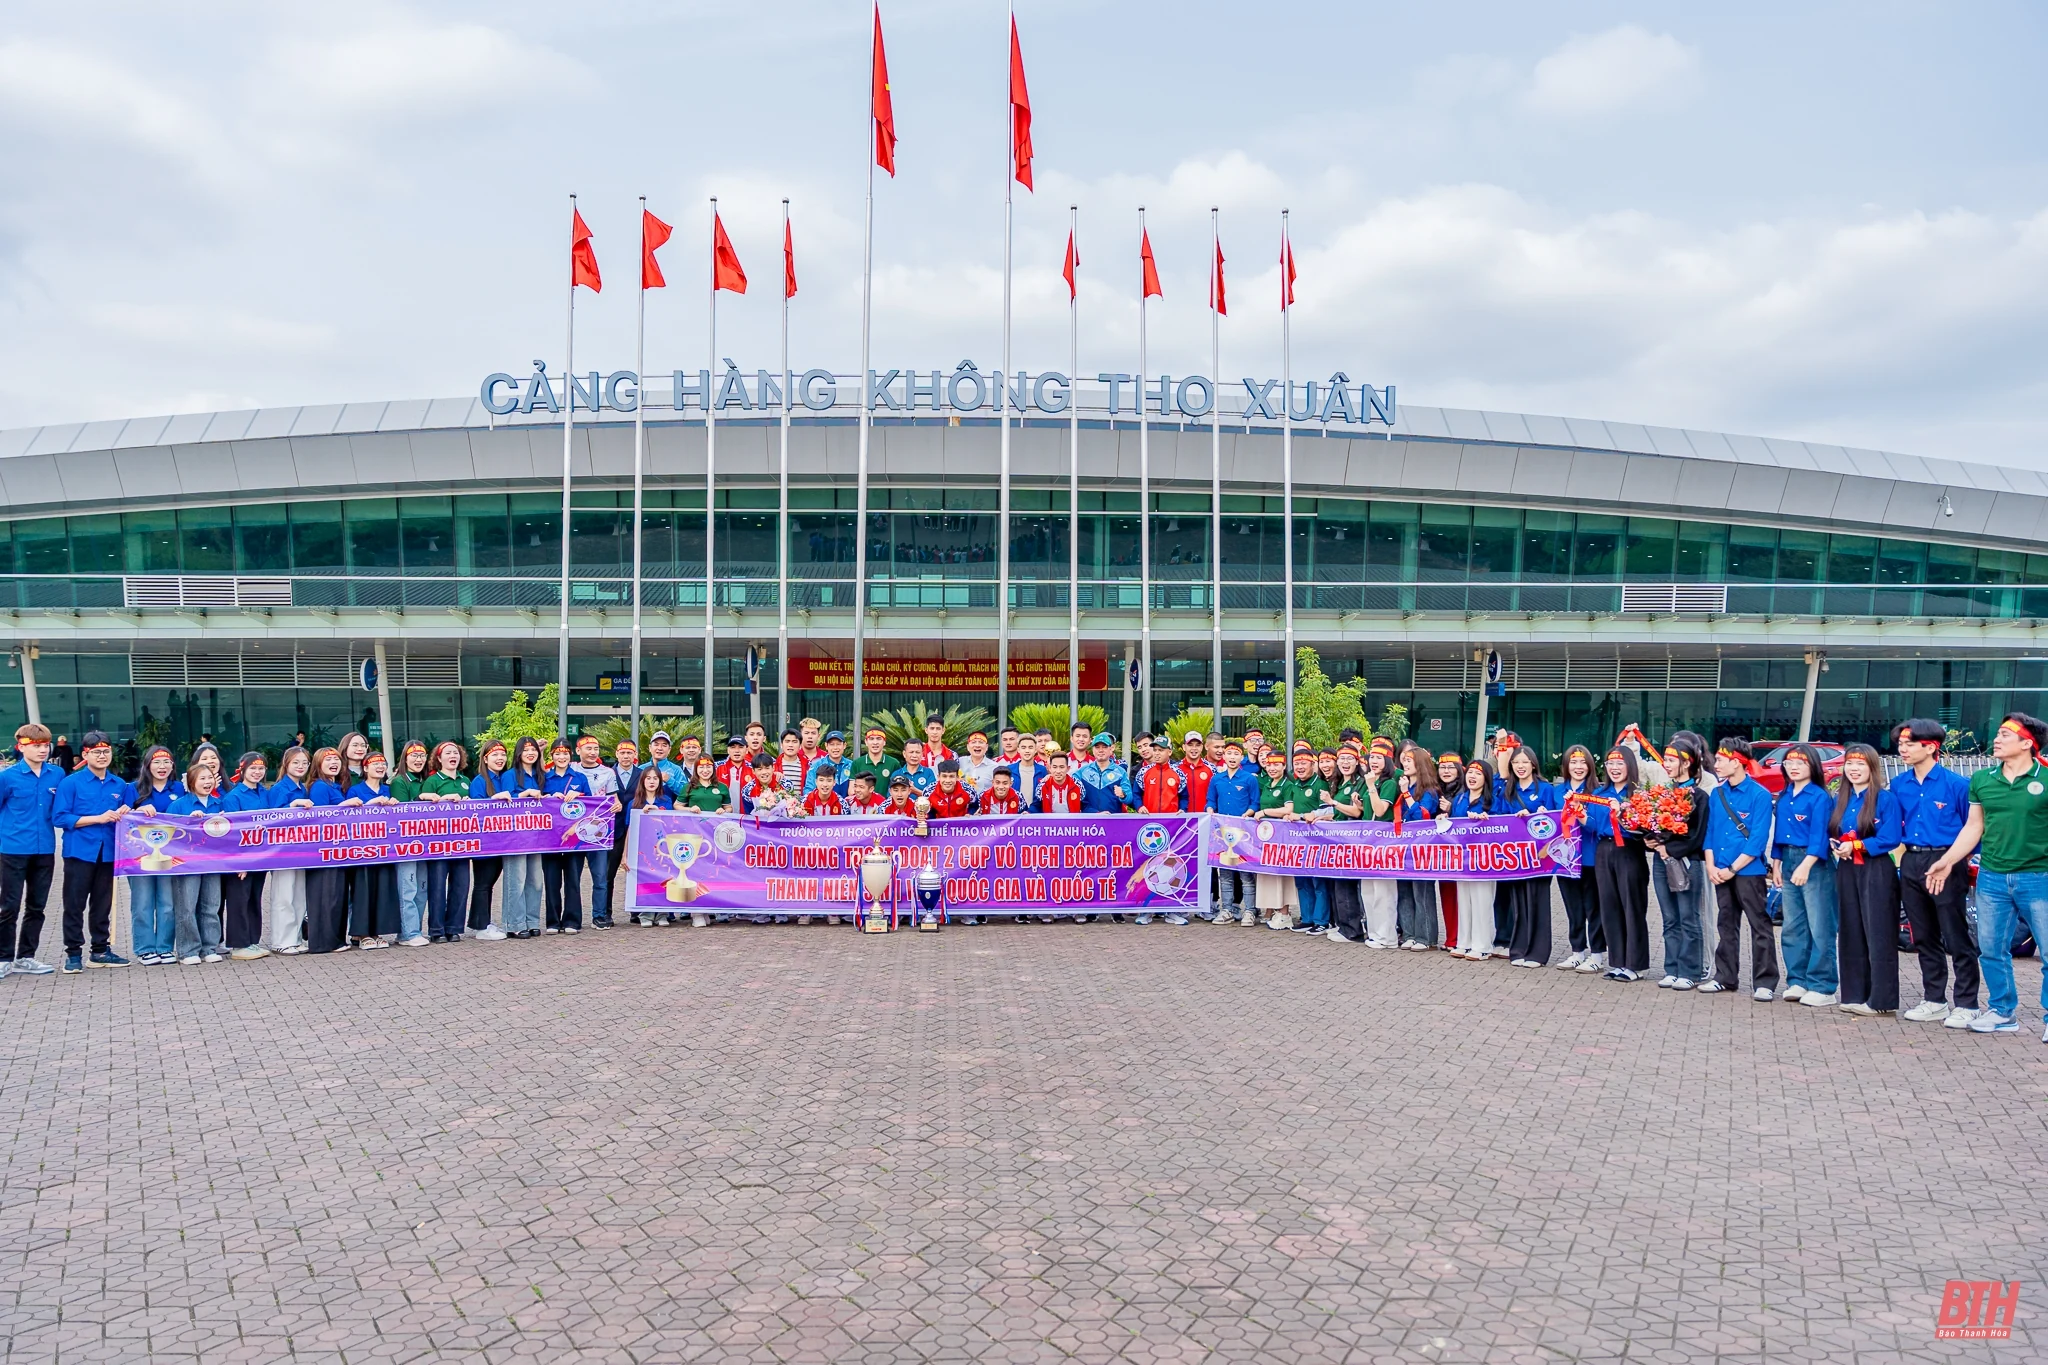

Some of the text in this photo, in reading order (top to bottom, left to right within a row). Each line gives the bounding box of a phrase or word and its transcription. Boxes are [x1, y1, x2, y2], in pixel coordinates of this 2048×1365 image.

[480, 357, 1396, 426] CẢNG HÀNG KHÔNG THỌ XUÂN
[251, 811, 294, 822] TRƯỜNG
[297, 811, 315, 820] ĐẠI
[318, 809, 340, 819] HỌC
[342, 807, 362, 816] VĂN
[365, 805, 390, 815] HÓA,
[392, 803, 409, 814] THỂ
[411, 804, 436, 813] THAO
[438, 802, 452, 812] VÀ
[469, 803, 490, 812] LỊCH
[491, 801, 521, 810] THANH
[523, 799, 543, 809] HÓA
[239, 824, 263, 846] XỨ
[267, 826, 320, 844] THANH
[322, 823, 349, 845] ĐỊA
[352, 821, 387, 839] LINH
[399, 818, 448, 837] THANH
[451, 813, 481, 834] HOÁ
[482, 815, 513, 833] ANH
[515, 811, 552, 831] HÙNG
[779, 827, 823, 837] TRƯỜNG
[826, 827, 845, 840] ĐẠI
[849, 827, 872, 840] HỌC
[875, 825, 897, 837] VĂN
[930, 822, 948, 837] THỂ
[951, 826, 979, 837] THAO
[982, 824, 996, 837] VÀ
[1000, 826, 1014, 837] DU
[1017, 826, 1041, 839] LỊCH
[1044, 826, 1079, 837] THANH
[1082, 824, 1106, 837] HÓA
[1289, 829, 1310, 838] THANH
[1311, 829, 1324, 837] HOA
[1325, 829, 1362, 837] UNIVERSITY
[1450, 828, 1466, 836] AND
[1469, 825, 1509, 835] TOURISM
[319, 839, 481, 862] TUCST VÔ ĐỊCH
[744, 841, 788, 869] CHÀO
[793, 842, 839, 869] MỪNG
[944, 845, 955, 869] 2
[958, 844, 990, 869] CUP
[994, 841, 1017, 869] VÔ
[1020, 844, 1059, 872] ĐỊCH
[1064, 841, 1107, 869] BÓNG
[1111, 841, 1134, 869] ĐÁ
[1260, 841, 1541, 871] MAKE IT LEGENDARY WITH TUCST!
[765, 877, 818, 901] THANH
[822, 874, 858, 901] NIÊN
[946, 871, 990, 905] QUỐC
[994, 877, 1021, 901] GIA
[1024, 874, 1046, 901] VÀ
[1050, 871, 1093, 904] QUỐC
[1098, 869, 1117, 901] TẾ
